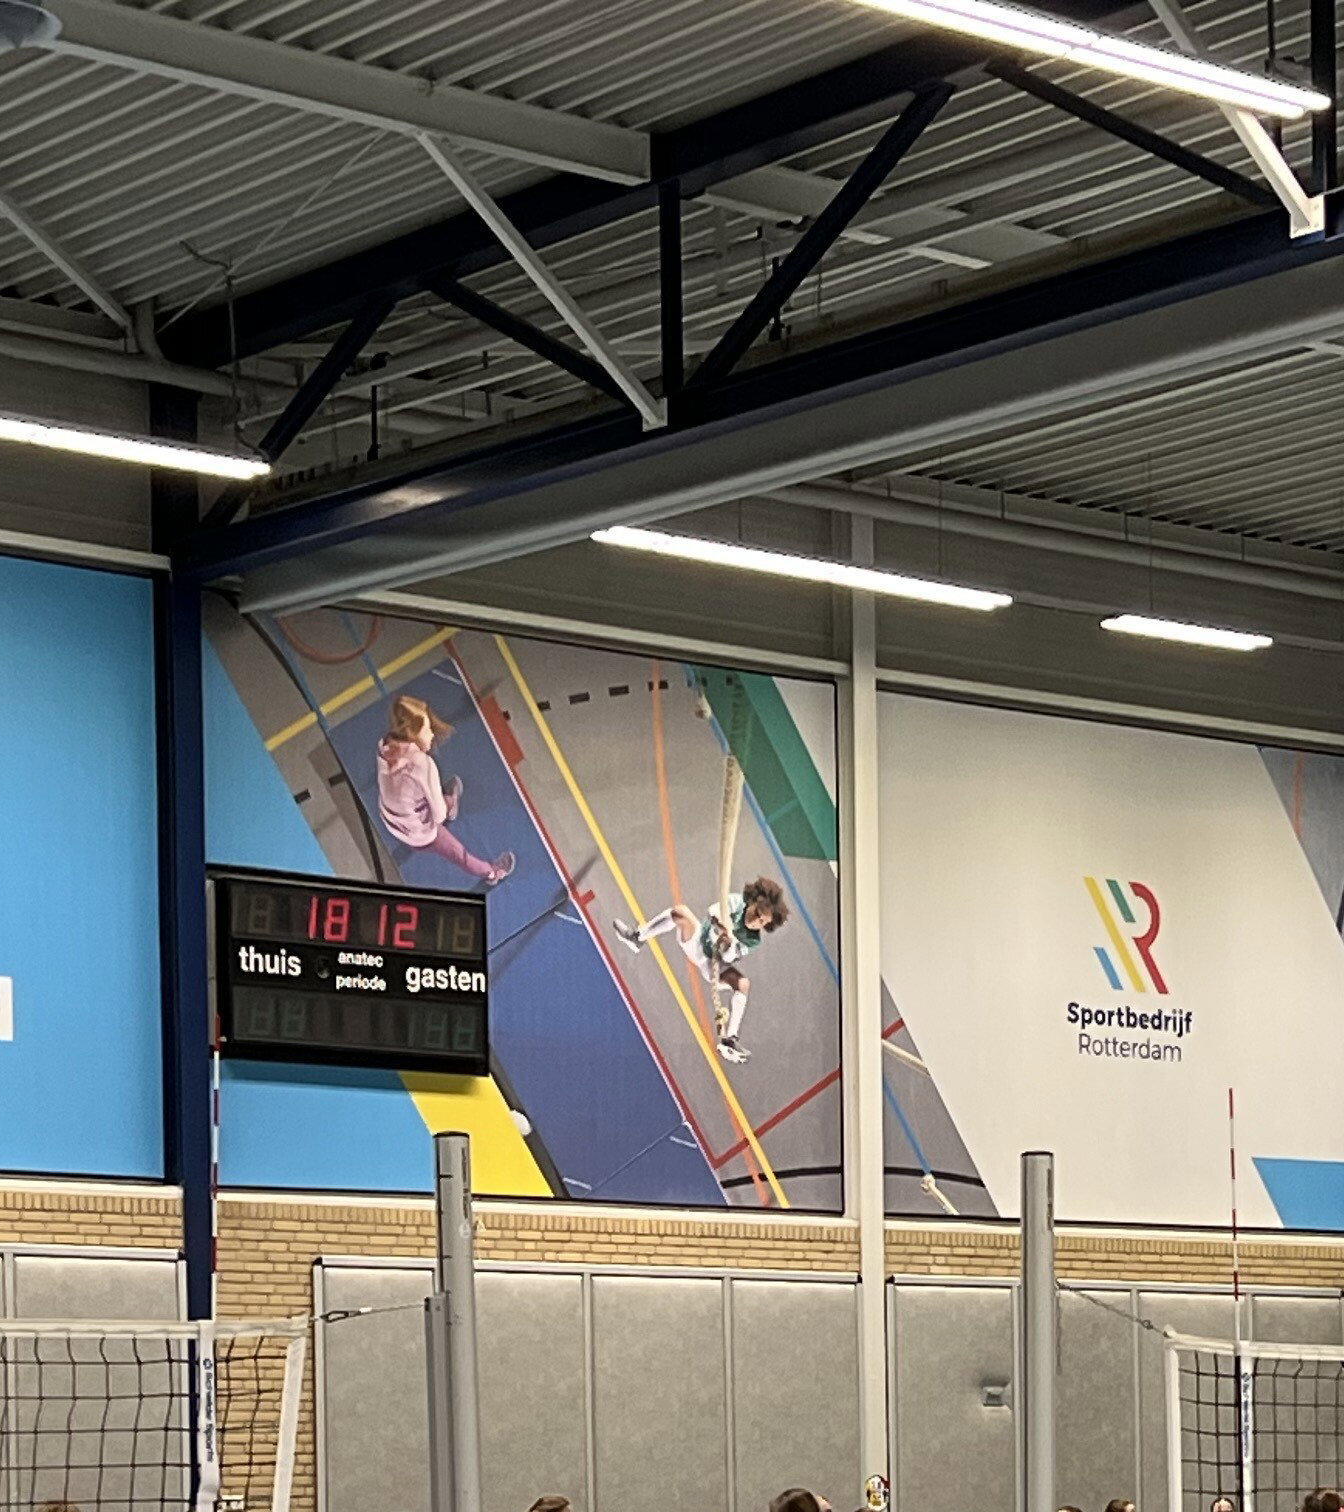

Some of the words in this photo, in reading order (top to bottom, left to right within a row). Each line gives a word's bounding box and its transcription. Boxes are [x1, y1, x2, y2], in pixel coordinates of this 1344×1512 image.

[238, 945, 302, 977] thuis
[405, 965, 486, 993] gasten
[335, 973, 387, 992] periode
[1066, 1002, 1193, 1038] Sportbedrijf
[1078, 1032, 1182, 1062] Rotterdam
